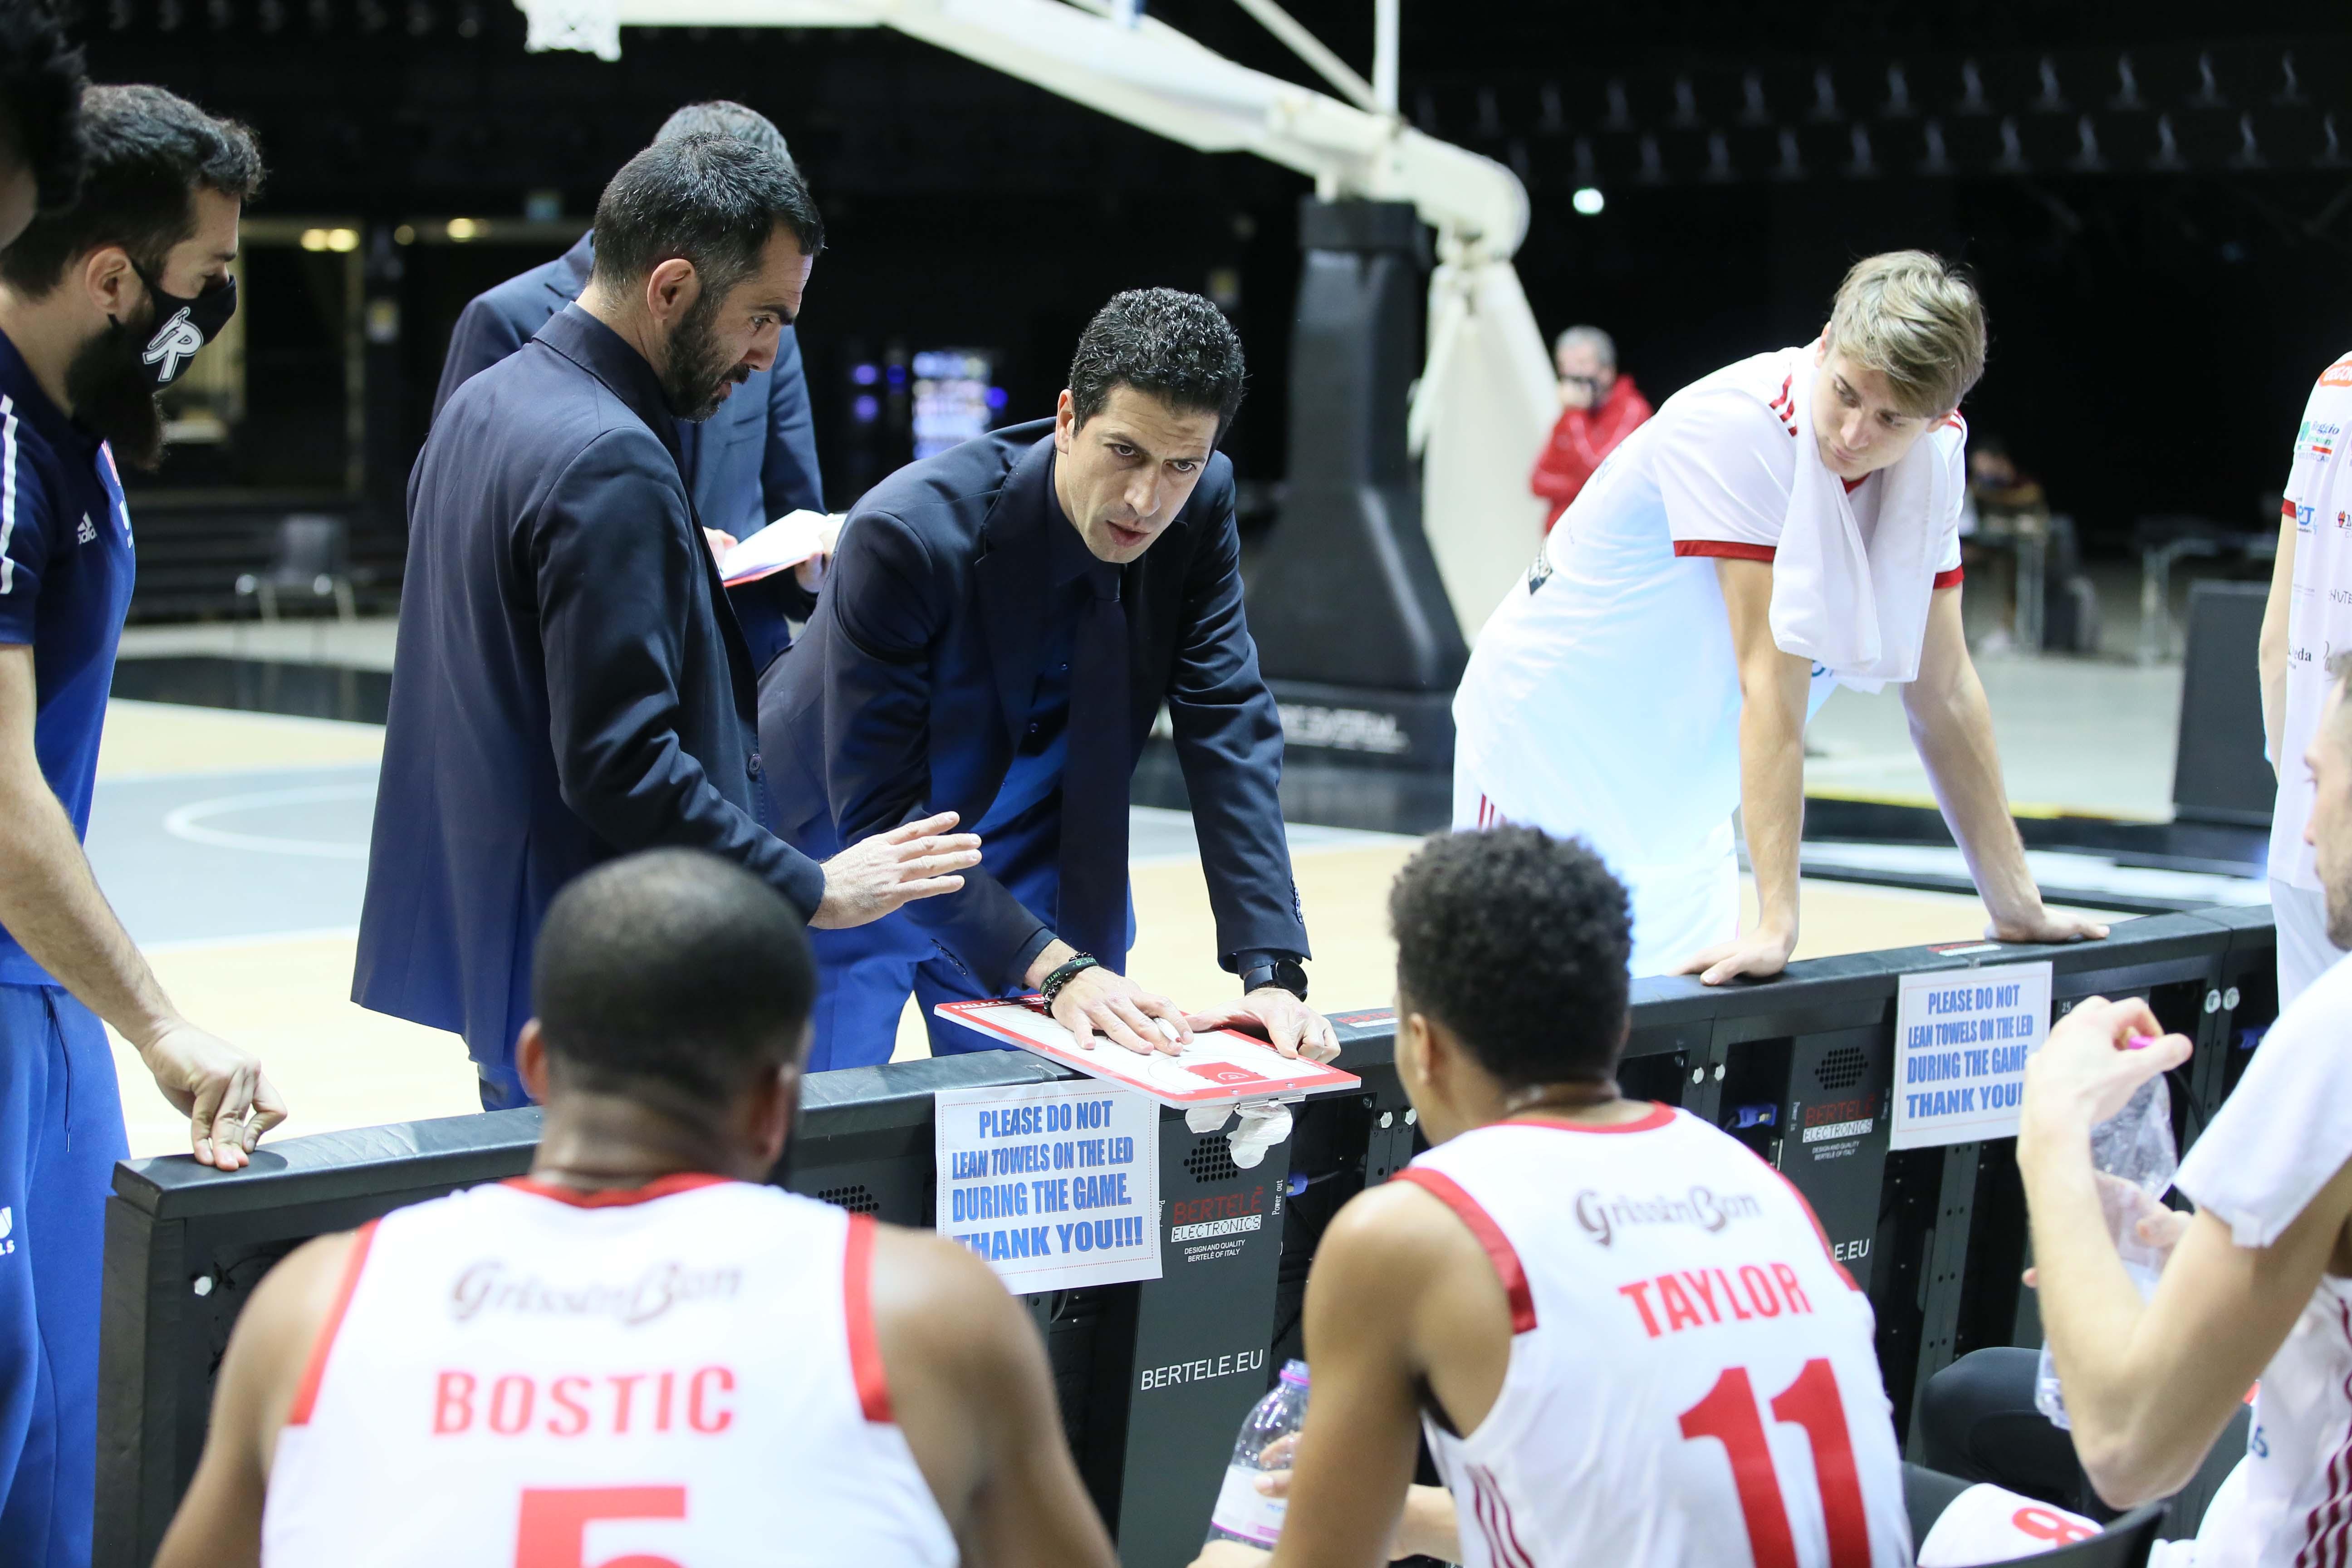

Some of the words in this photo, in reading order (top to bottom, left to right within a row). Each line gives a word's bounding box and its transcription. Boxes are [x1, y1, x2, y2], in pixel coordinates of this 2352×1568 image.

[1928, 989, 1972, 1015] PLEASE
[1976, 987, 1993, 1010] DO
[1996, 984, 2020, 1008] NOT
[1908, 1024, 1933, 1049] LEAN
[1936, 1020, 1977, 1046] TOWELS
[1980, 1019, 1994, 1042] ON
[1996, 1016, 2014, 1040] THE
[2017, 1014, 2033, 1037] LED
[1907, 1051, 1960, 1084] DURING
[1964, 1049, 1989, 1077] THE
[980, 1106, 1042, 1138] PLEASE
[1047, 1104, 1071, 1132] DO
[1077, 1101, 1113, 1129] NOT
[1906, 1088, 1975, 1119] THANK
[1804, 1119, 1872, 1141] ELECTRONICS
[953, 1150, 988, 1180] LEAN
[992, 1143, 1049, 1176] TOWELS
[1054, 1141, 1073, 1170] ON
[1078, 1139, 1104, 1166] THE
[1108, 1137, 1133, 1164] LED
[953, 1182, 1028, 1222] DURING
[1032, 1179, 1068, 1213] THE
[1073, 1173, 1132, 1210] GAME.
[1173, 1186, 1264, 1224] BERTELÈ
[1272, 1194, 1282, 1216] Power
[1056, 1216, 1143, 1253] YOU!!!
[1173, 1216, 1260, 1241] ELECTRONICS
[1574, 1186, 1763, 1247] GrissinBon
[1184, 1245, 1207, 1255] DESIGN
[1207, 1243, 1220, 1252] AND
[1220, 1240, 1245, 1249] QUALITY
[1188, 1251, 1215, 1263] BERTELÈ
[1215, 1250, 1225, 1259] OF
[1225, 1248, 1240, 1256] ITALY
[1618, 1264, 1813, 1338] TAYLOR
[1141, 1349, 1264, 1391] BERTELE.EU
[433, 1366, 735, 1437] BOSTIC
[1677, 1358, 1873, 1568] 11
